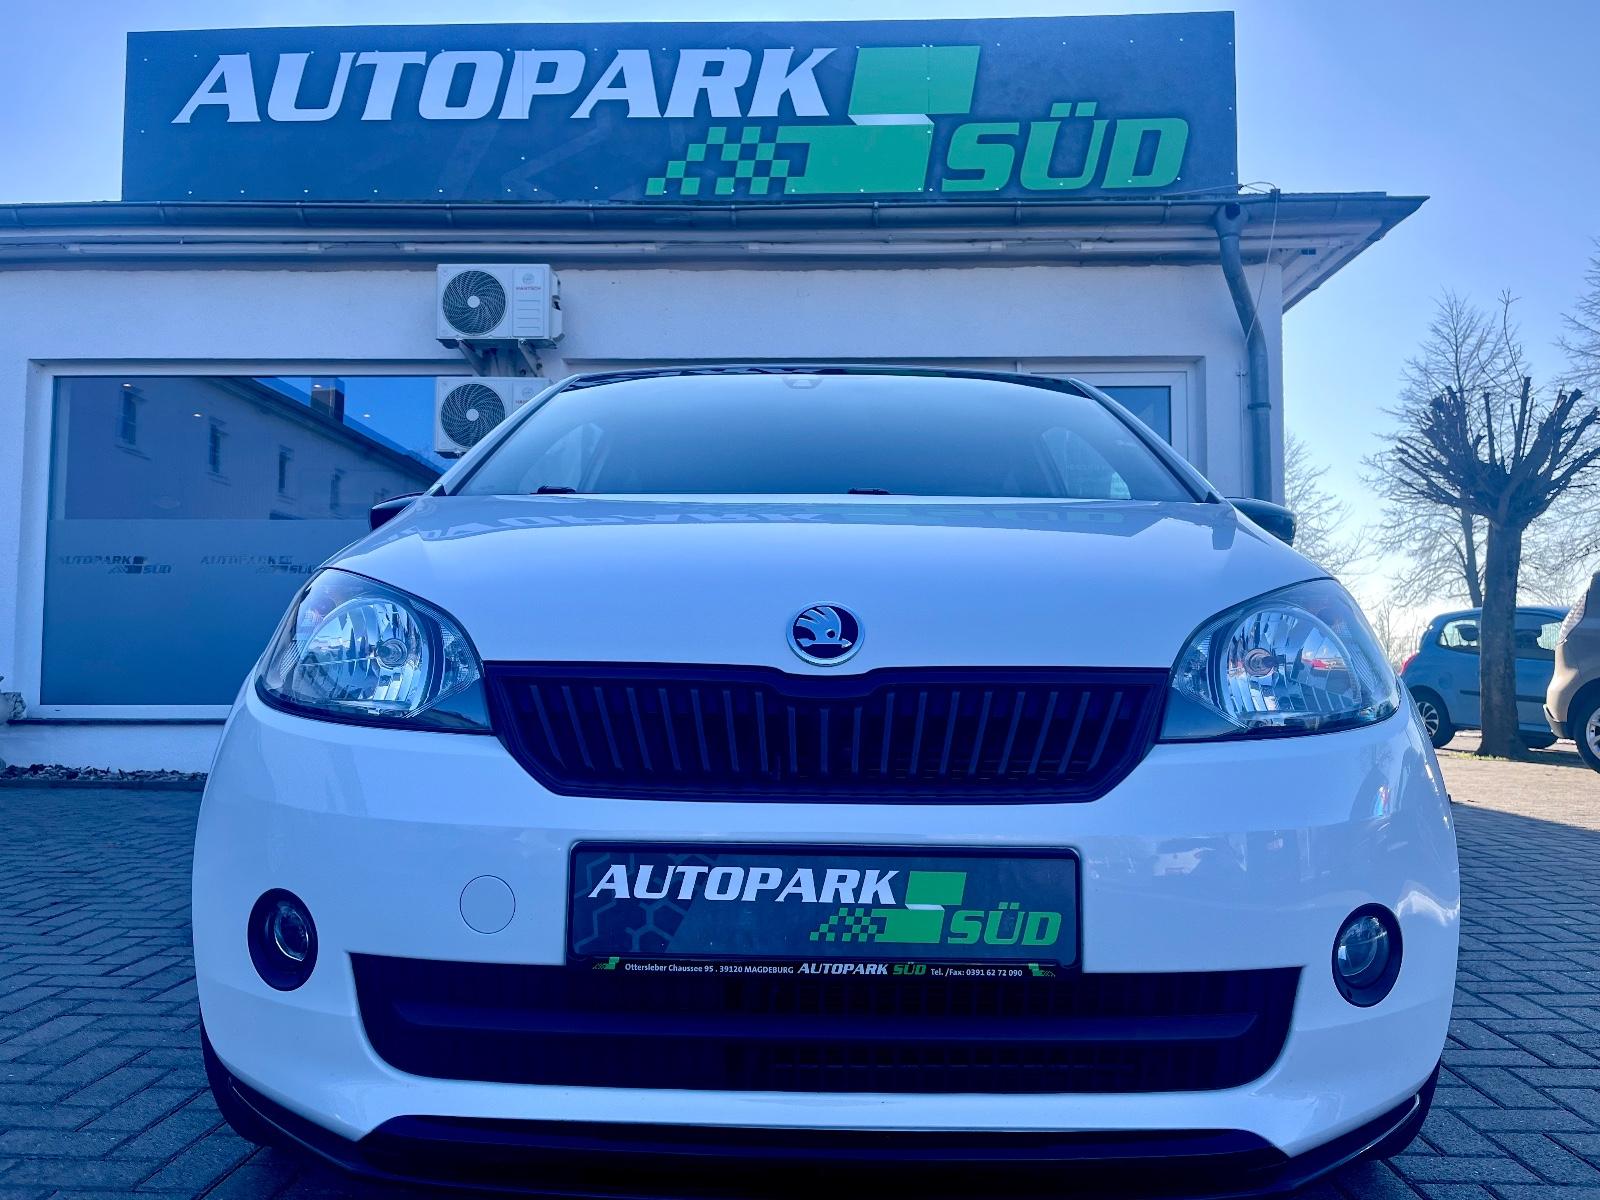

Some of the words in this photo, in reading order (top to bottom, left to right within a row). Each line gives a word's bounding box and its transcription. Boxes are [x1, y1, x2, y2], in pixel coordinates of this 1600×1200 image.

[172, 46, 837, 124] AUTOPARK
[942, 101, 1190, 192] SÜD
[588, 864, 900, 905] AUTOPARK
[947, 901, 1062, 946] SÜD
[624, 963, 667, 972] Ottersleber
[668, 964, 703, 973] Chaussee
[704, 965, 714, 973] 95
[719, 965, 743, 973] 39120
[744, 965, 794, 974] MAGDEBURG
[797, 962, 889, 975] AUTOPARK
[892, 961, 927, 976] SÜD
[930, 968, 943, 976] Tel.
[965, 968, 985, 977] 0391
[997, 969, 1007, 977] 72
[1008, 969, 1023, 977] 090
